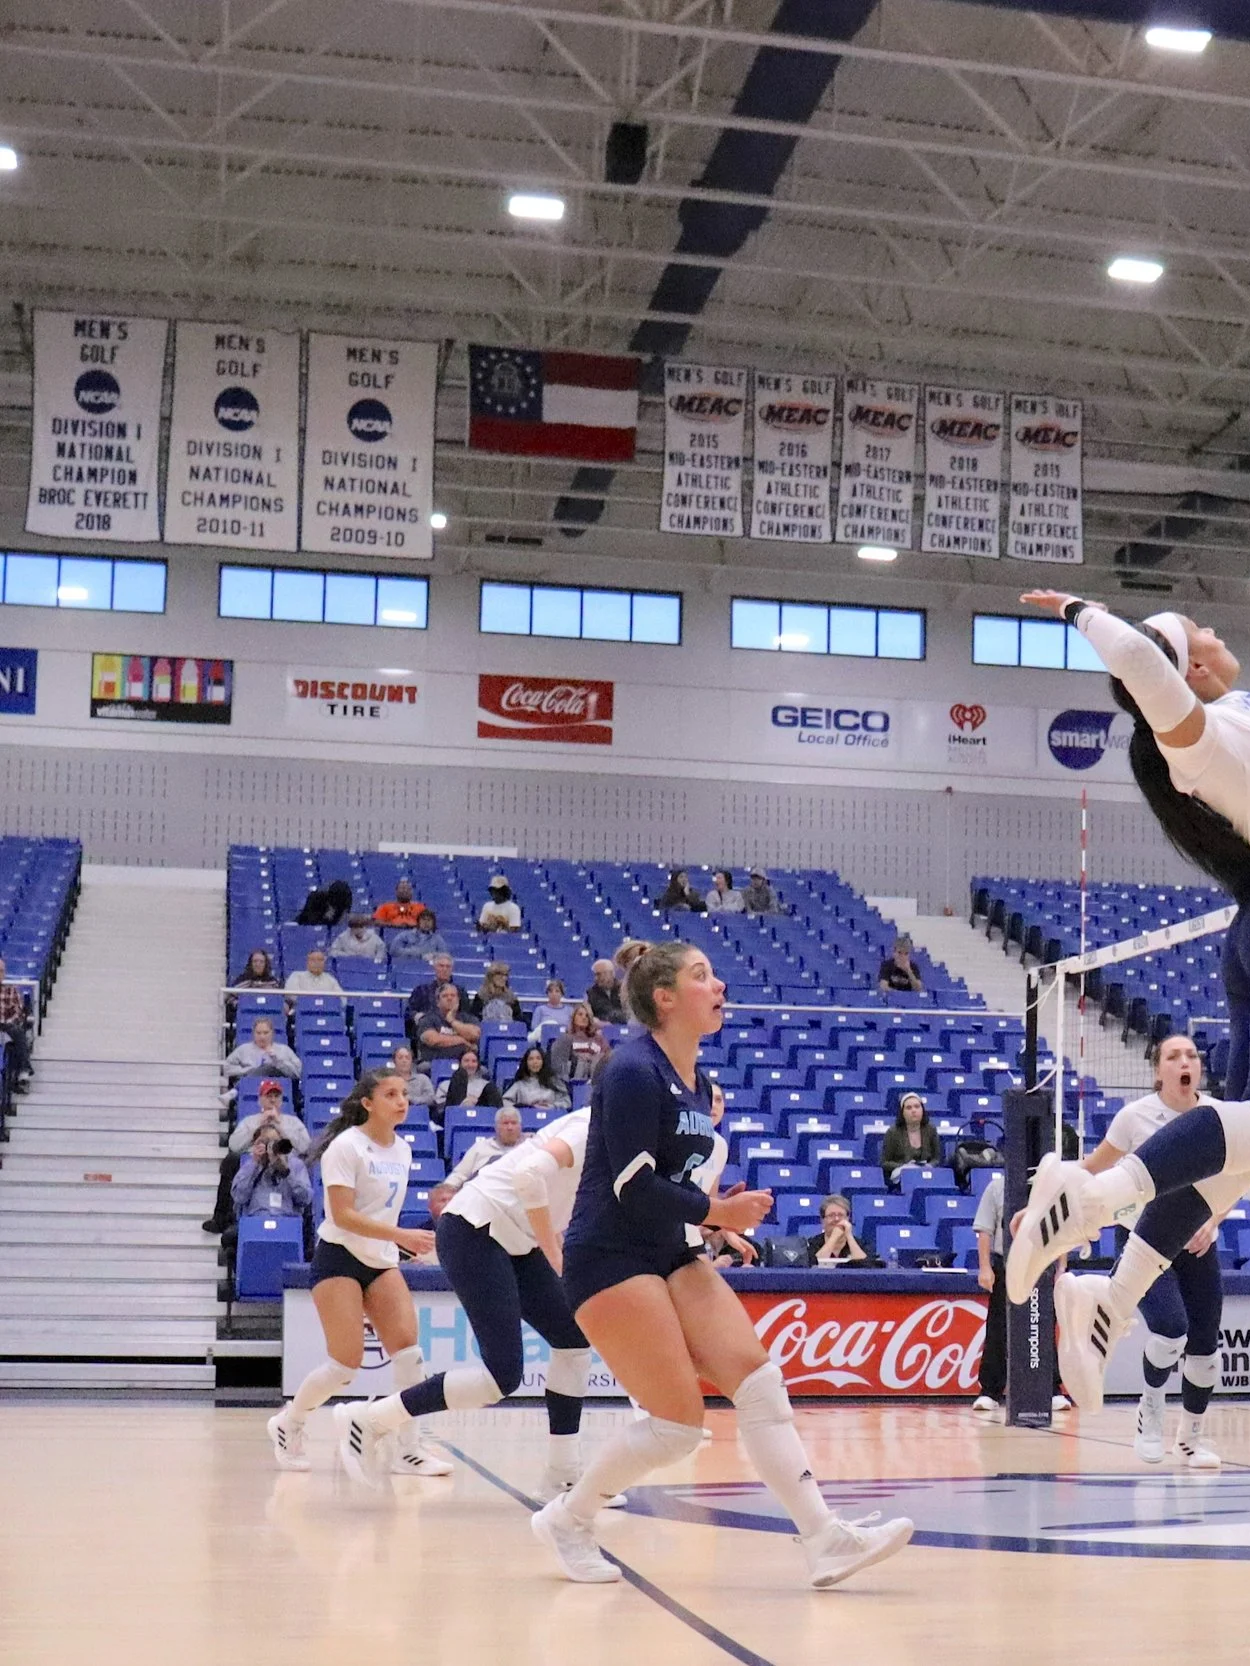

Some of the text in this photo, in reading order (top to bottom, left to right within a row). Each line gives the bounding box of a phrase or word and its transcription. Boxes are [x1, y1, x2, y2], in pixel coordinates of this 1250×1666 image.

[74, 319, 128, 340] MEN'S
[215, 334, 265, 353] MEN'S
[80, 344, 119, 364] GOLF
[346, 348, 399, 365] MEN'S
[216, 360, 262, 378] GOLF
[348, 373, 395, 390] GOLF
[52, 418, 127, 438] DIVISION
[56, 442, 134, 463] NATIONAL
[186, 440, 262, 461] DIVISION
[322, 450, 398, 470] DIVISION
[53, 465, 137, 486] CHAMPION
[189, 467, 277, 488] NATIONAL
[676, 473, 731, 490] ATHLETIC
[324, 476, 412, 498] NATIONAL
[767, 481, 820, 499] ATHLETIC
[851, 483, 903, 503] ATHLETIC
[38, 488, 149, 510] BROC EVERETT
[181, 491, 284, 513] CHAMPIONS
[666, 493, 738, 511] CONFERENCE
[937, 495, 990, 513] ATHLETIC
[317, 501, 419, 523] CHAMPIONS
[756, 500, 825, 519] CONFERENCE
[841, 503, 910, 524] CONFERENCE
[1020, 503, 1069, 519] ATHLETIC
[75, 513, 111, 531] 2018
[197, 518, 265, 538] 2010-11
[669, 513, 735, 532] CHAMPIONS
[759, 521, 823, 540] CHAMPIONS
[927, 515, 996, 534] CONFERENCE
[1012, 521, 1078, 540] CONFERENCE
[330, 527, 405, 548] 2009-10
[844, 524, 906, 543] CHAMPIONS
[930, 534, 992, 553] CHAMPIONS
[1014, 541, 1075, 559] CHAMPIONS
[293, 679, 418, 704] DISCOUNT
[500, 683, 589, 716] Coca-Cola
[327, 704, 381, 718] TIRE
[771, 705, 890, 732] GEICO
[798, 731, 889, 748] Local Office
[385, 1182, 398, 1208] 7
[1030, 1288, 1040, 1369] sports imports
[754, 1299, 987, 1389] Coca-Col
